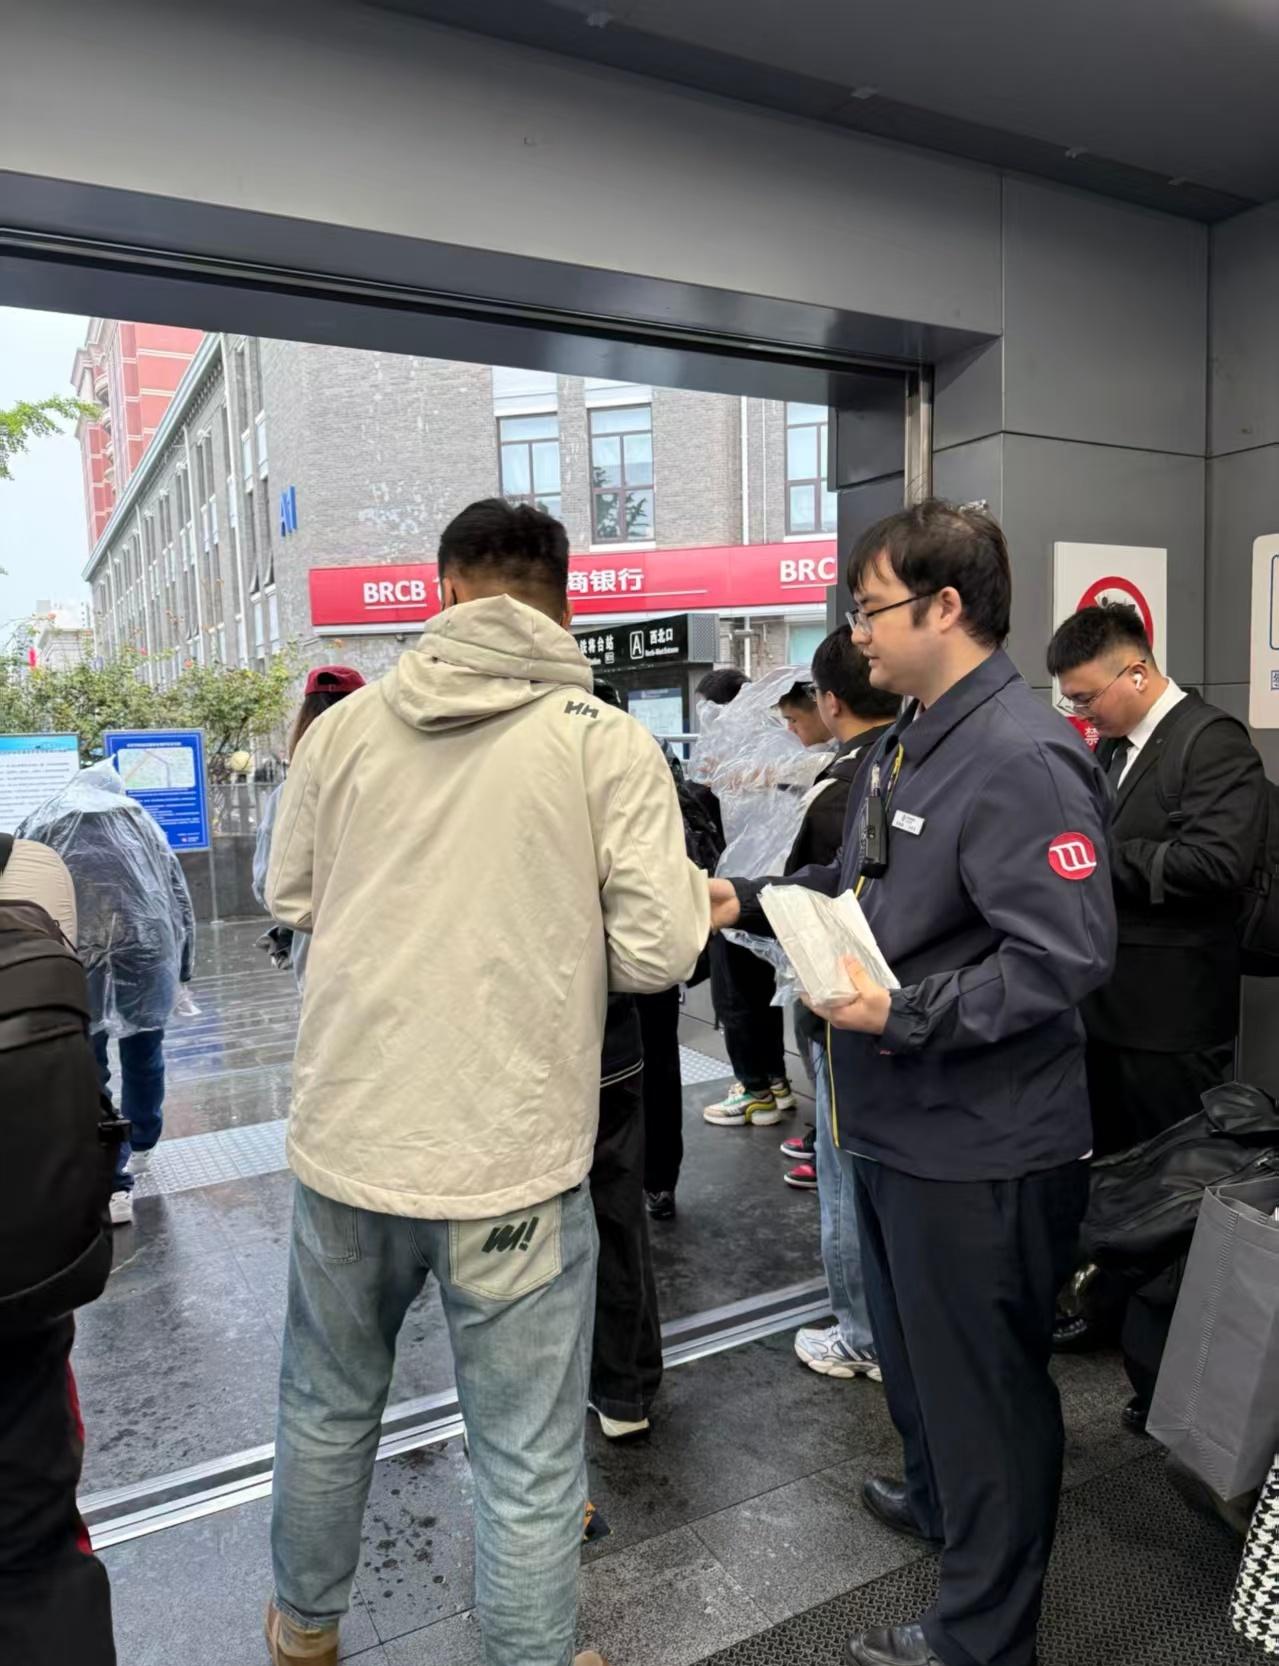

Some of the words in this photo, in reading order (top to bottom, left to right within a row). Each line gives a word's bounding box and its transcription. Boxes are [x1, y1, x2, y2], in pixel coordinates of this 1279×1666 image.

[568, 568, 645, 593] 商银行
[780, 557, 836, 582] BRC
[363, 580, 426, 604] BRCB
[632, 634, 642, 655] A
[649, 628, 673, 645] 西北口
[1084, 726, 1100, 746] 禁
